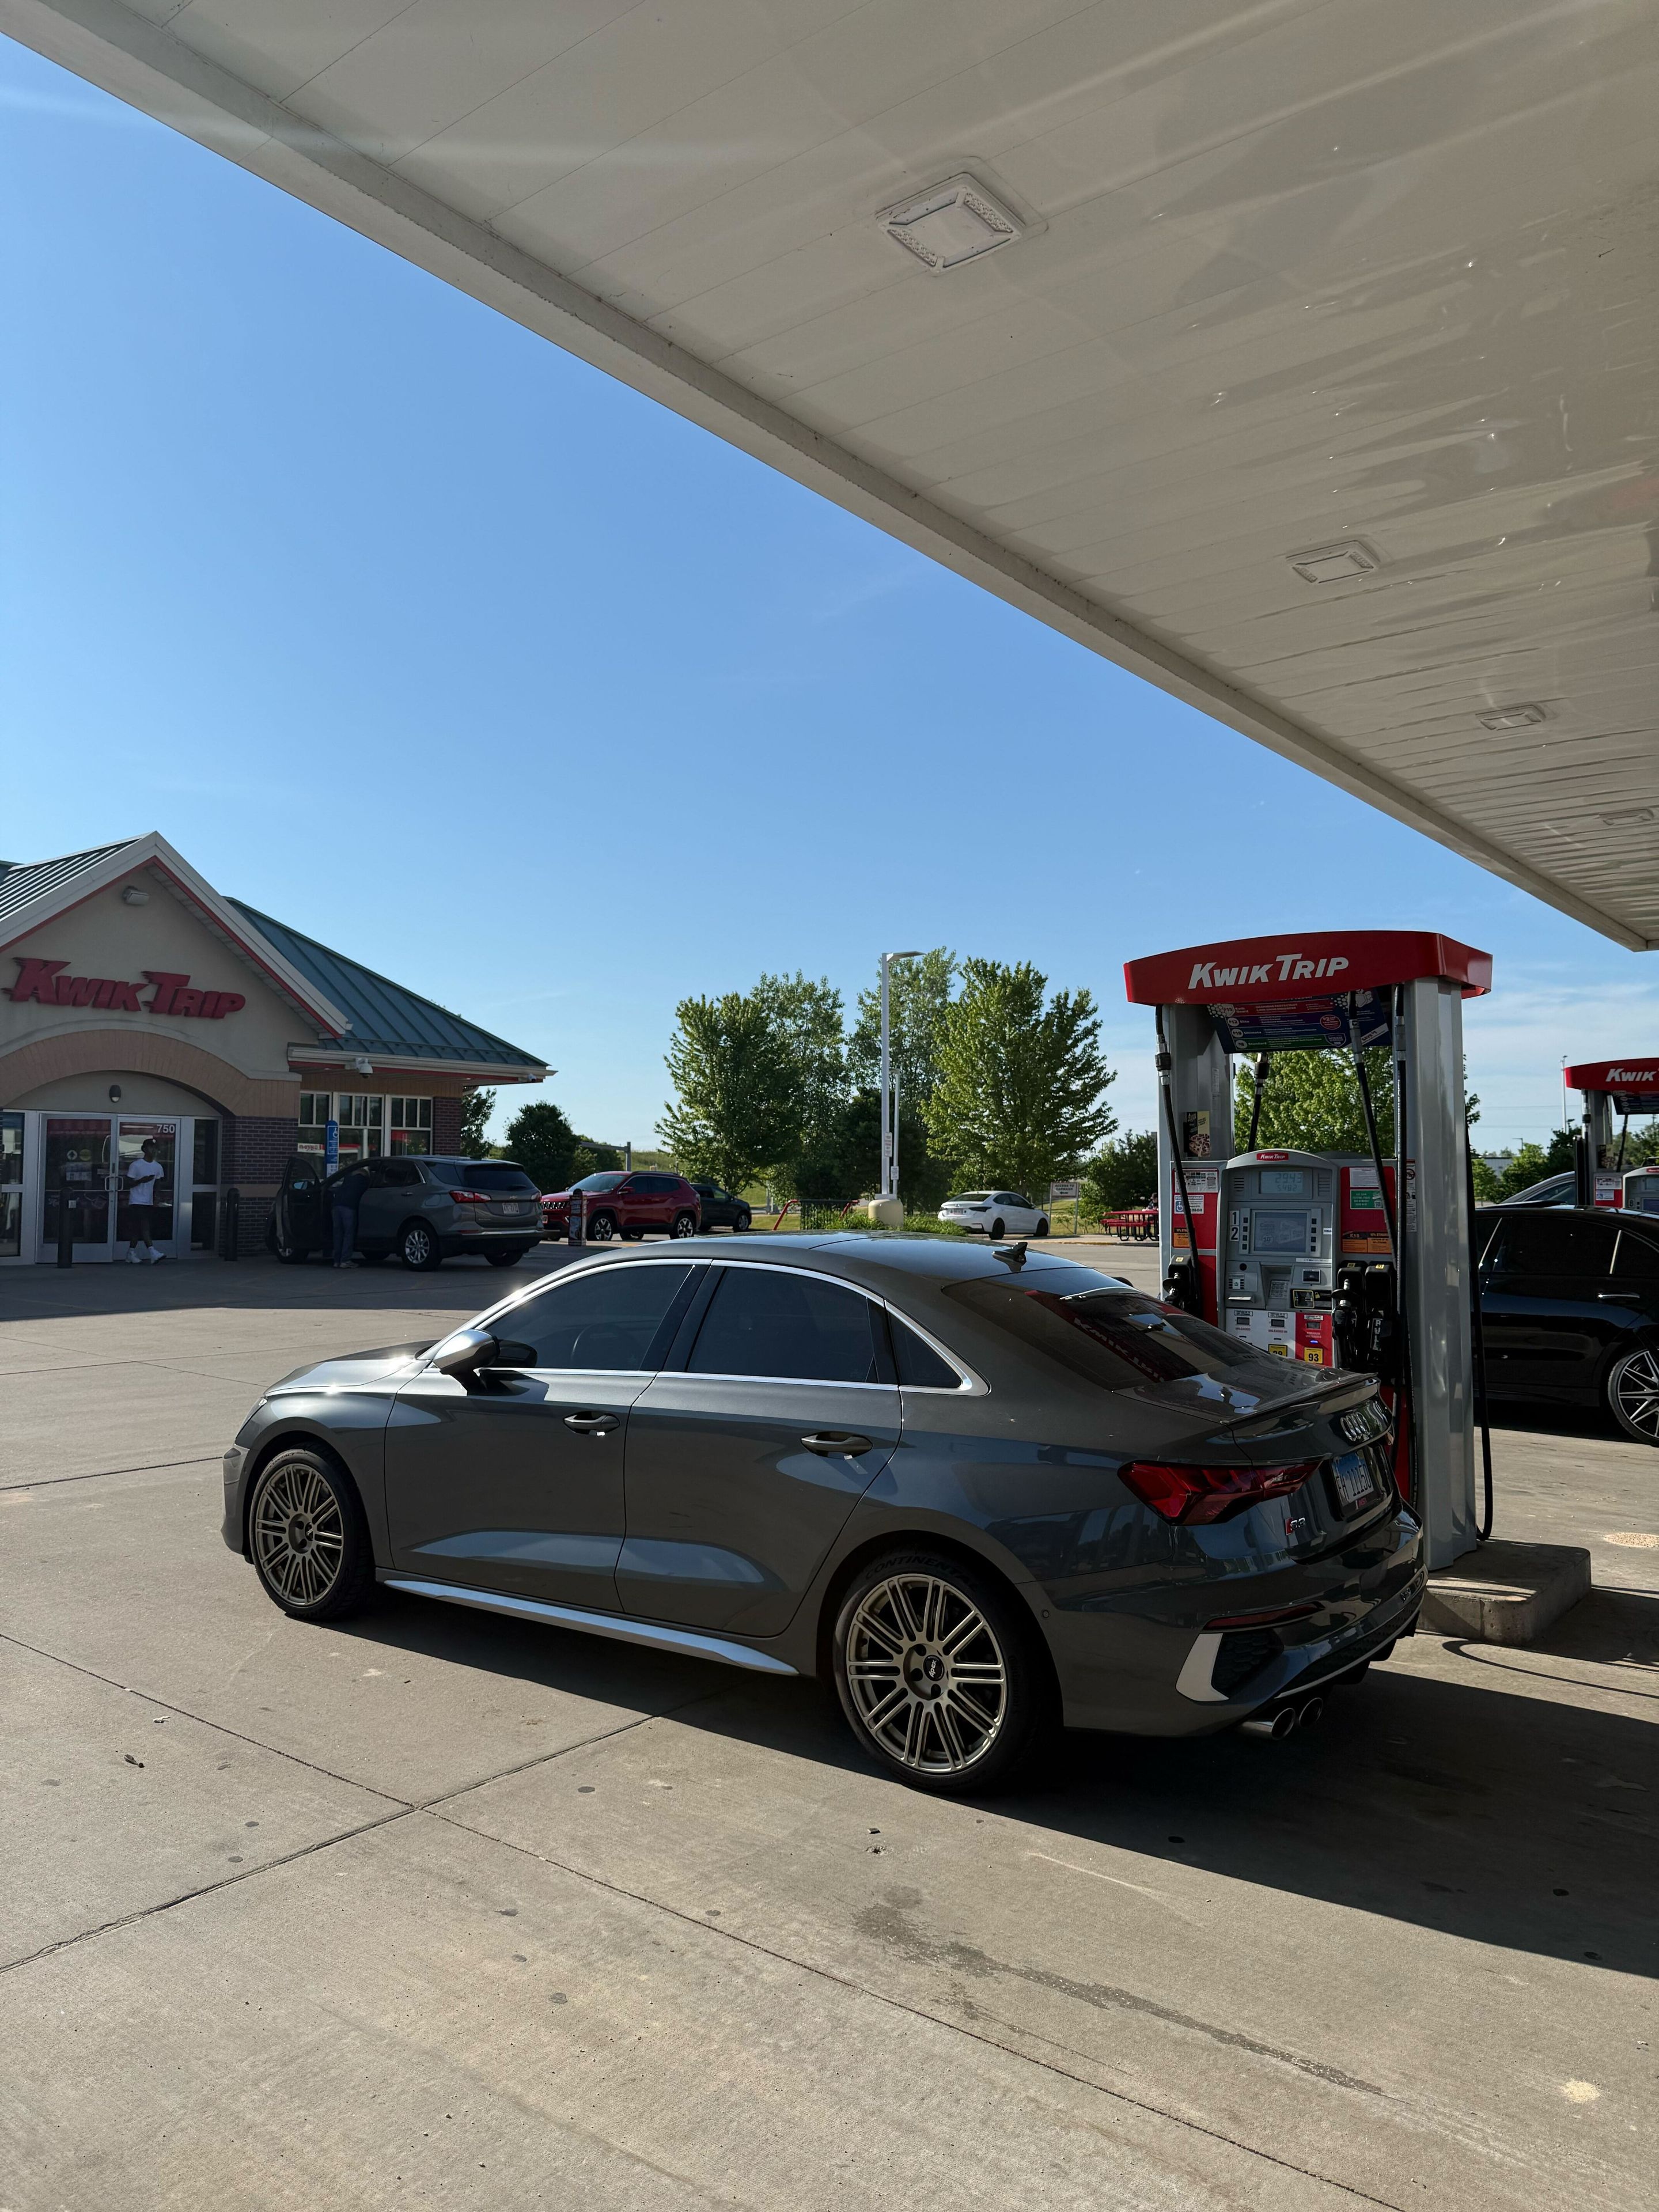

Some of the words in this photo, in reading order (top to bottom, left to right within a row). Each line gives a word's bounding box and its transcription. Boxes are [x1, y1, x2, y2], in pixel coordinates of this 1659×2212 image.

[1188, 962, 1274, 989] KWIK
[1275, 953, 1349, 981] TRIP
[1, 957, 149, 1011] KWIK
[141, 970, 246, 1019] TRIP
[1605, 1069, 1657, 1082] KWIK
[157, 1124, 175, 1134] 750
[1232, 1211, 1237, 1225] 1
[1231, 1227, 1238, 1240] 2
[1308, 1353, 1319, 1362] 93
[1347, 1464, 1372, 1497] 11150
[1290, 1517, 1306, 1531] S3
